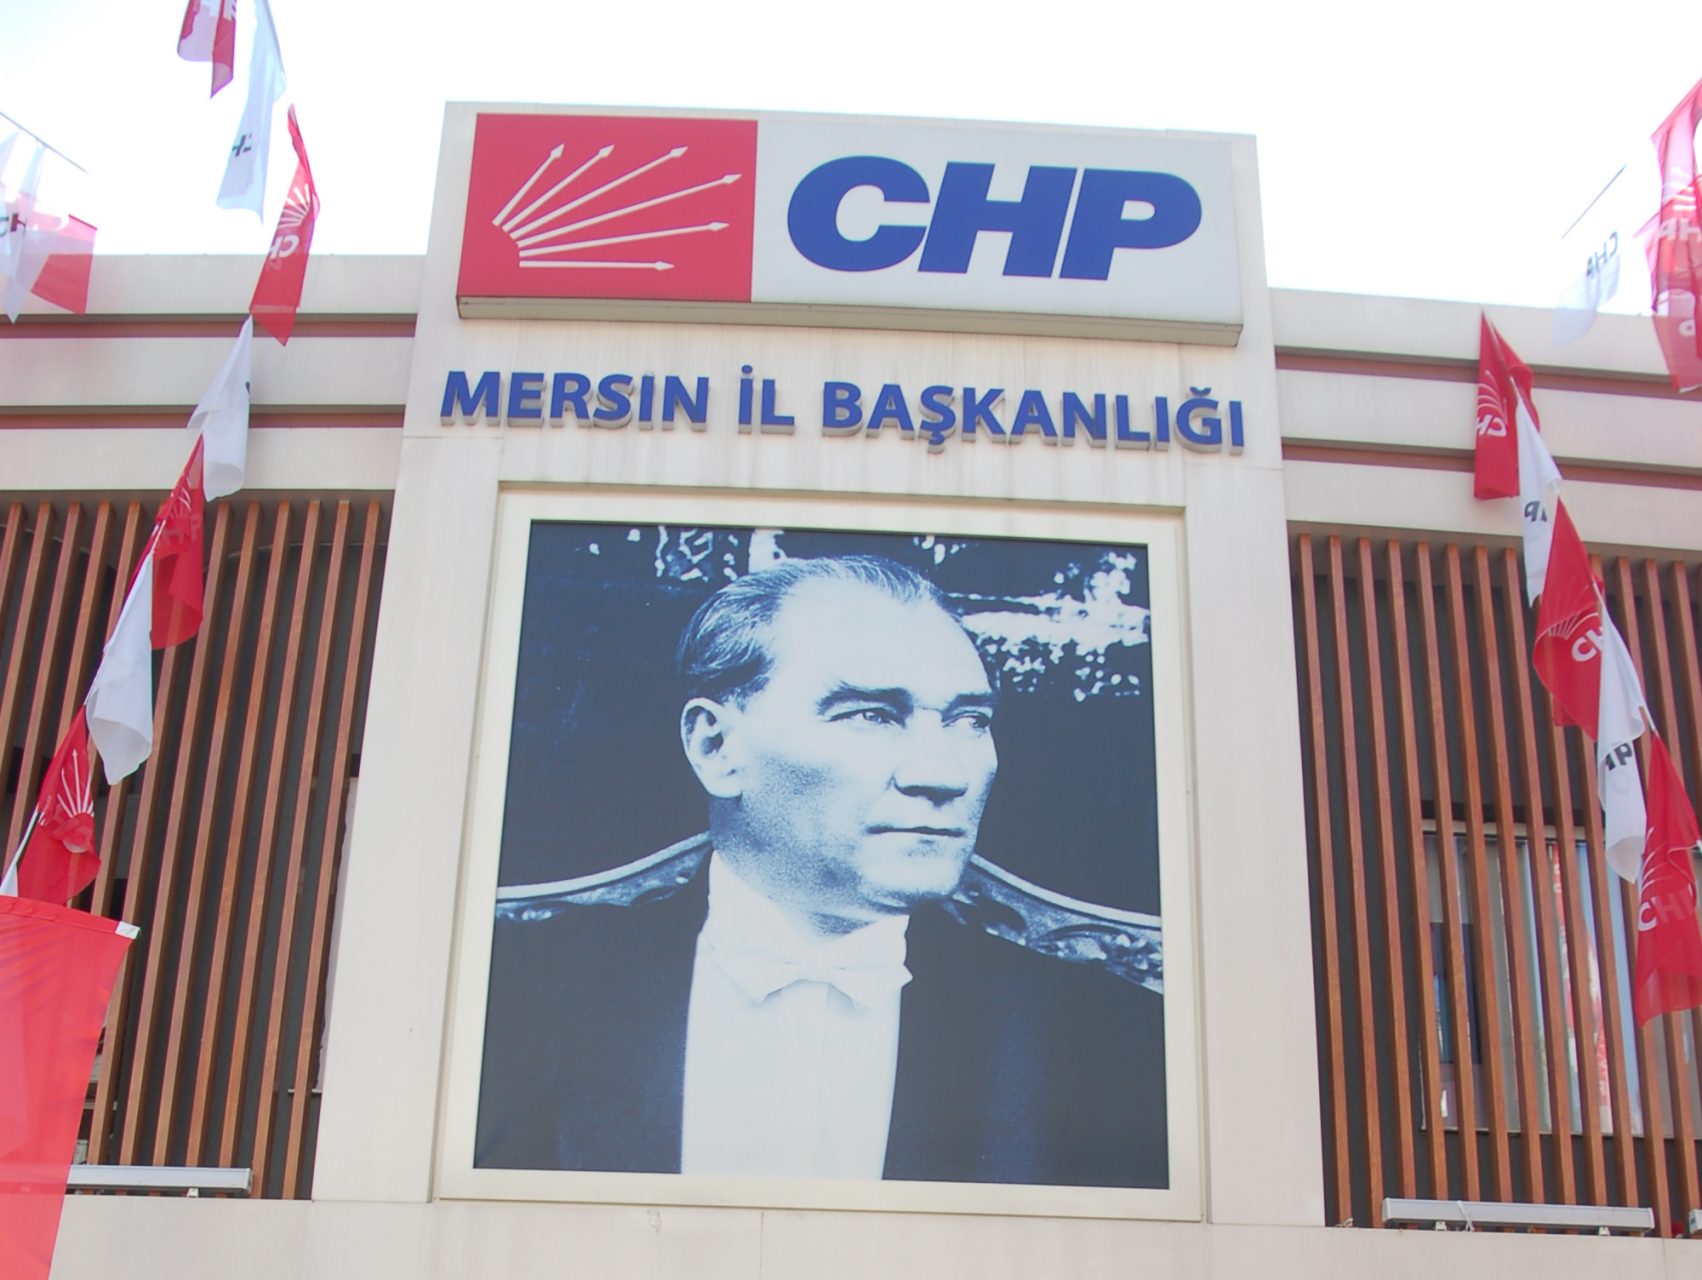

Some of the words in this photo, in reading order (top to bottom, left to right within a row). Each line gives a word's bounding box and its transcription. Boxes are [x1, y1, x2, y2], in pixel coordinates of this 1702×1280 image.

[787, 155, 1203, 281] CHP
[738, 364, 795, 426] İL
[822, 381, 1245, 447] BAŞKANLIĞI
